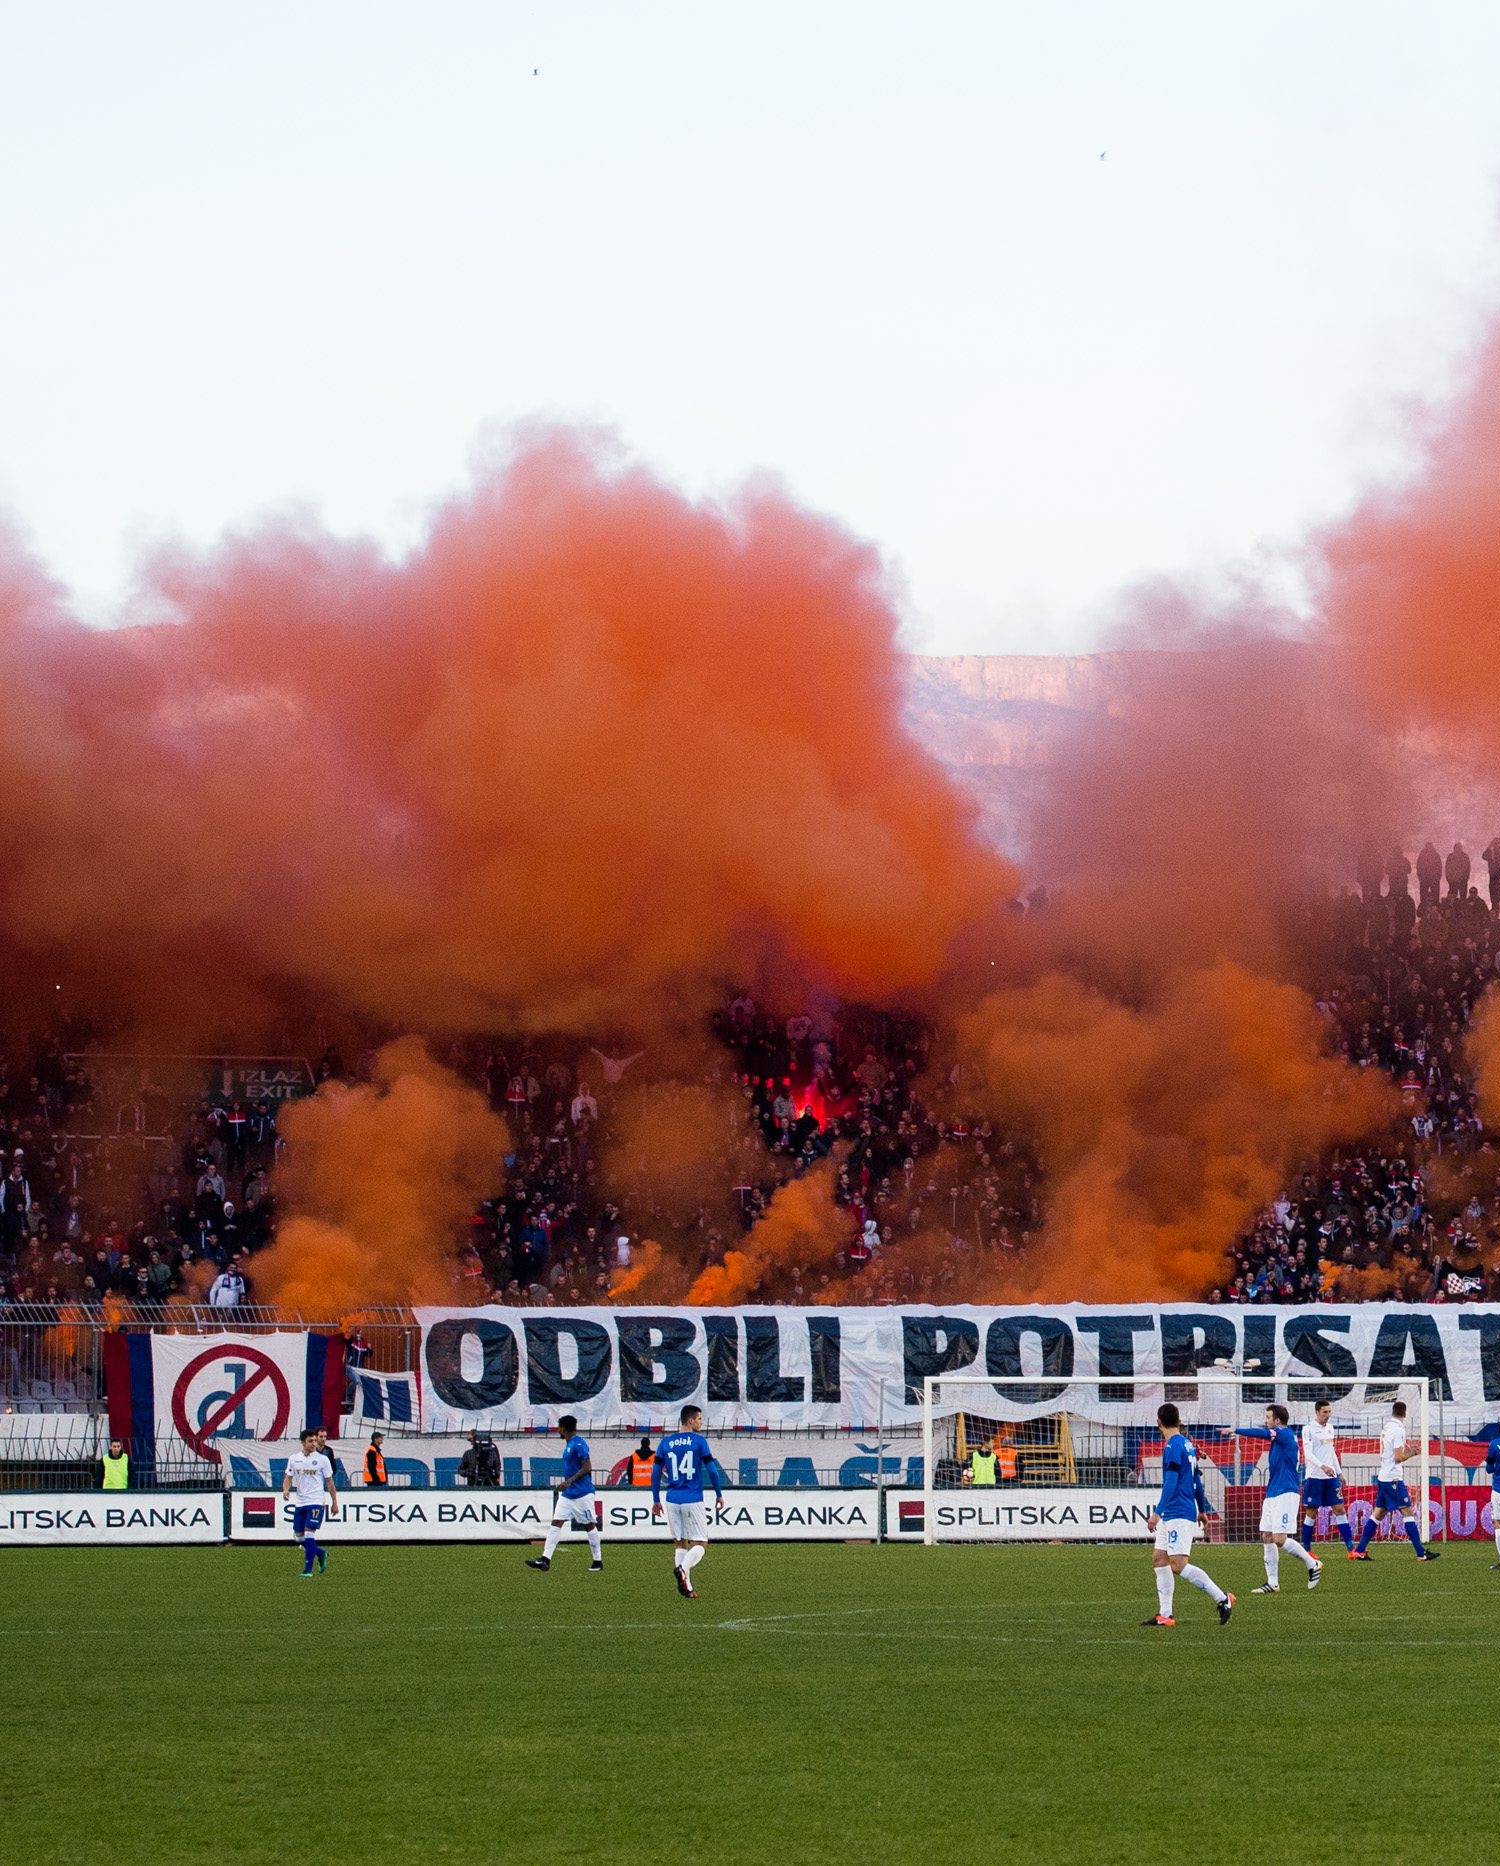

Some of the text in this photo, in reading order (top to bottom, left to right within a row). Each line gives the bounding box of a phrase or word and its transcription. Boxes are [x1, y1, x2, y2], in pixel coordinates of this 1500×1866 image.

[240, 1070, 303, 1083] IZLAZ
[246, 1085, 295, 1098] EXIT
[426, 1315, 841, 1410] ODBILI
[668, 1436, 693, 1449] gojak
[667, 1450, 696, 1481] 14
[106, 1507, 211, 1528] BANKA
[283, 1503, 541, 1523] SLITSKA BANKA
[610, 1506, 867, 1526] SPLKA BANKA
[937, 1505, 1157, 1526] SPLITSKA BAN
[1281, 1513, 1290, 1524] 8
